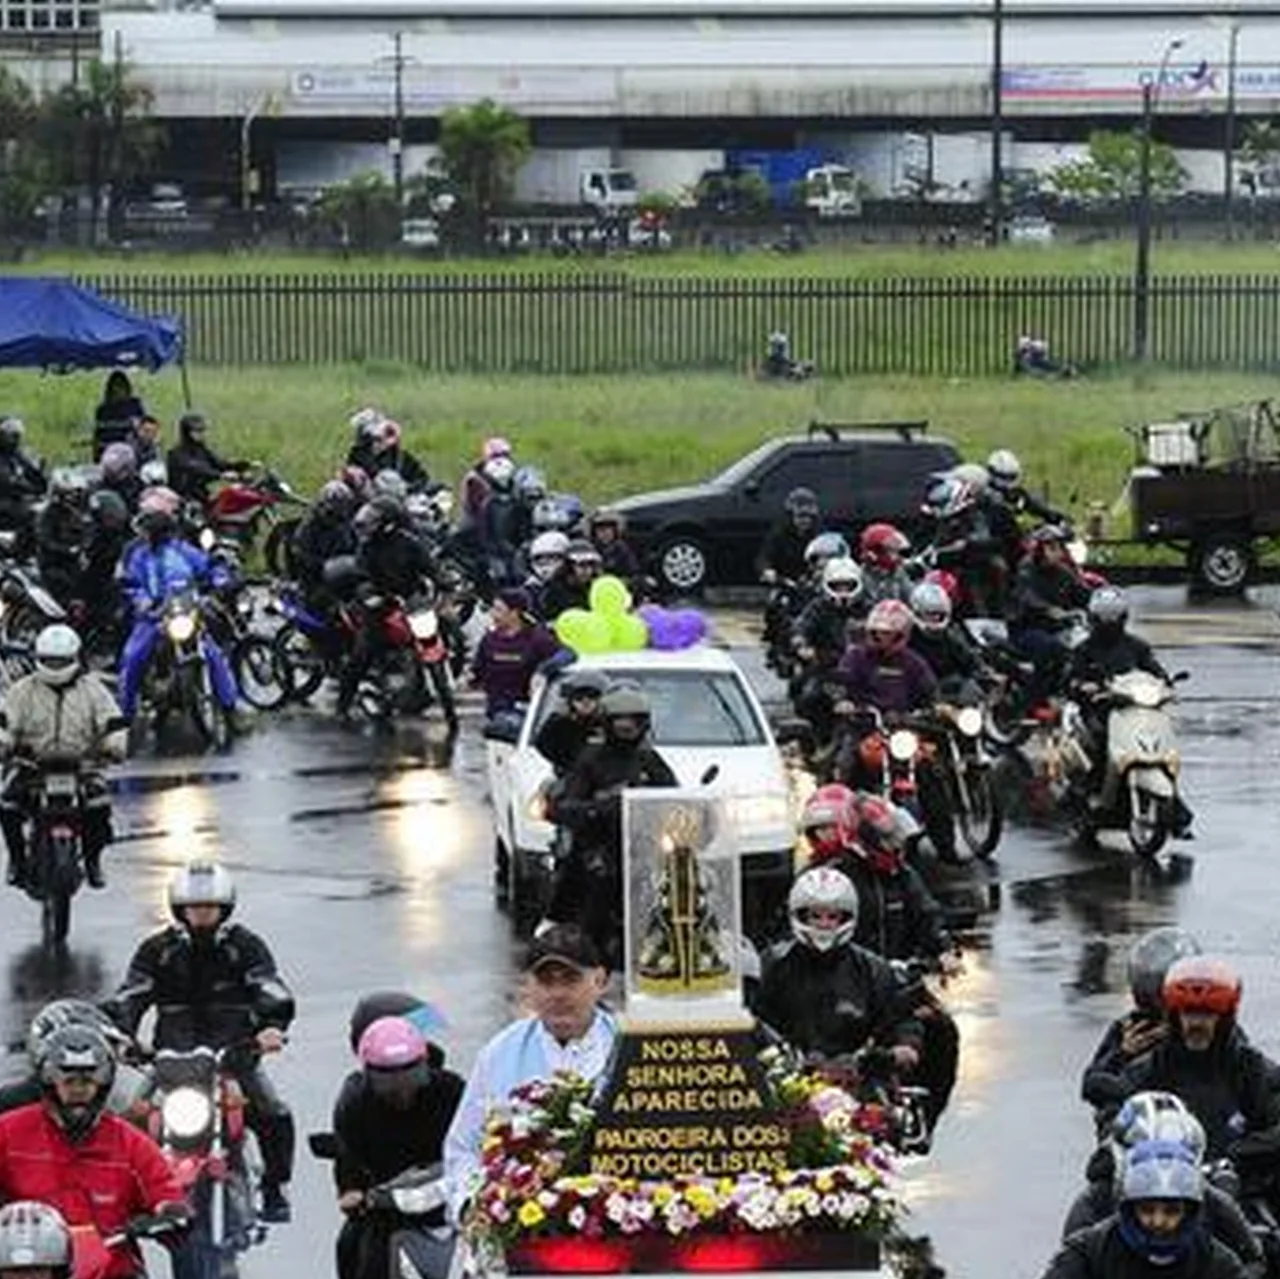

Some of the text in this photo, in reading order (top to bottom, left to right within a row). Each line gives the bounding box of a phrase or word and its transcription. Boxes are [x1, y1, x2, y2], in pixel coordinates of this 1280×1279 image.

[641, 1038, 731, 1060] NOSSA
[626, 1063, 746, 1087] SENHORA
[612, 1088, 763, 1112] APARECIDA
[595, 1126, 727, 1149] PADROEIRA
[590, 1150, 788, 1175] MOTOCICLISTAS
